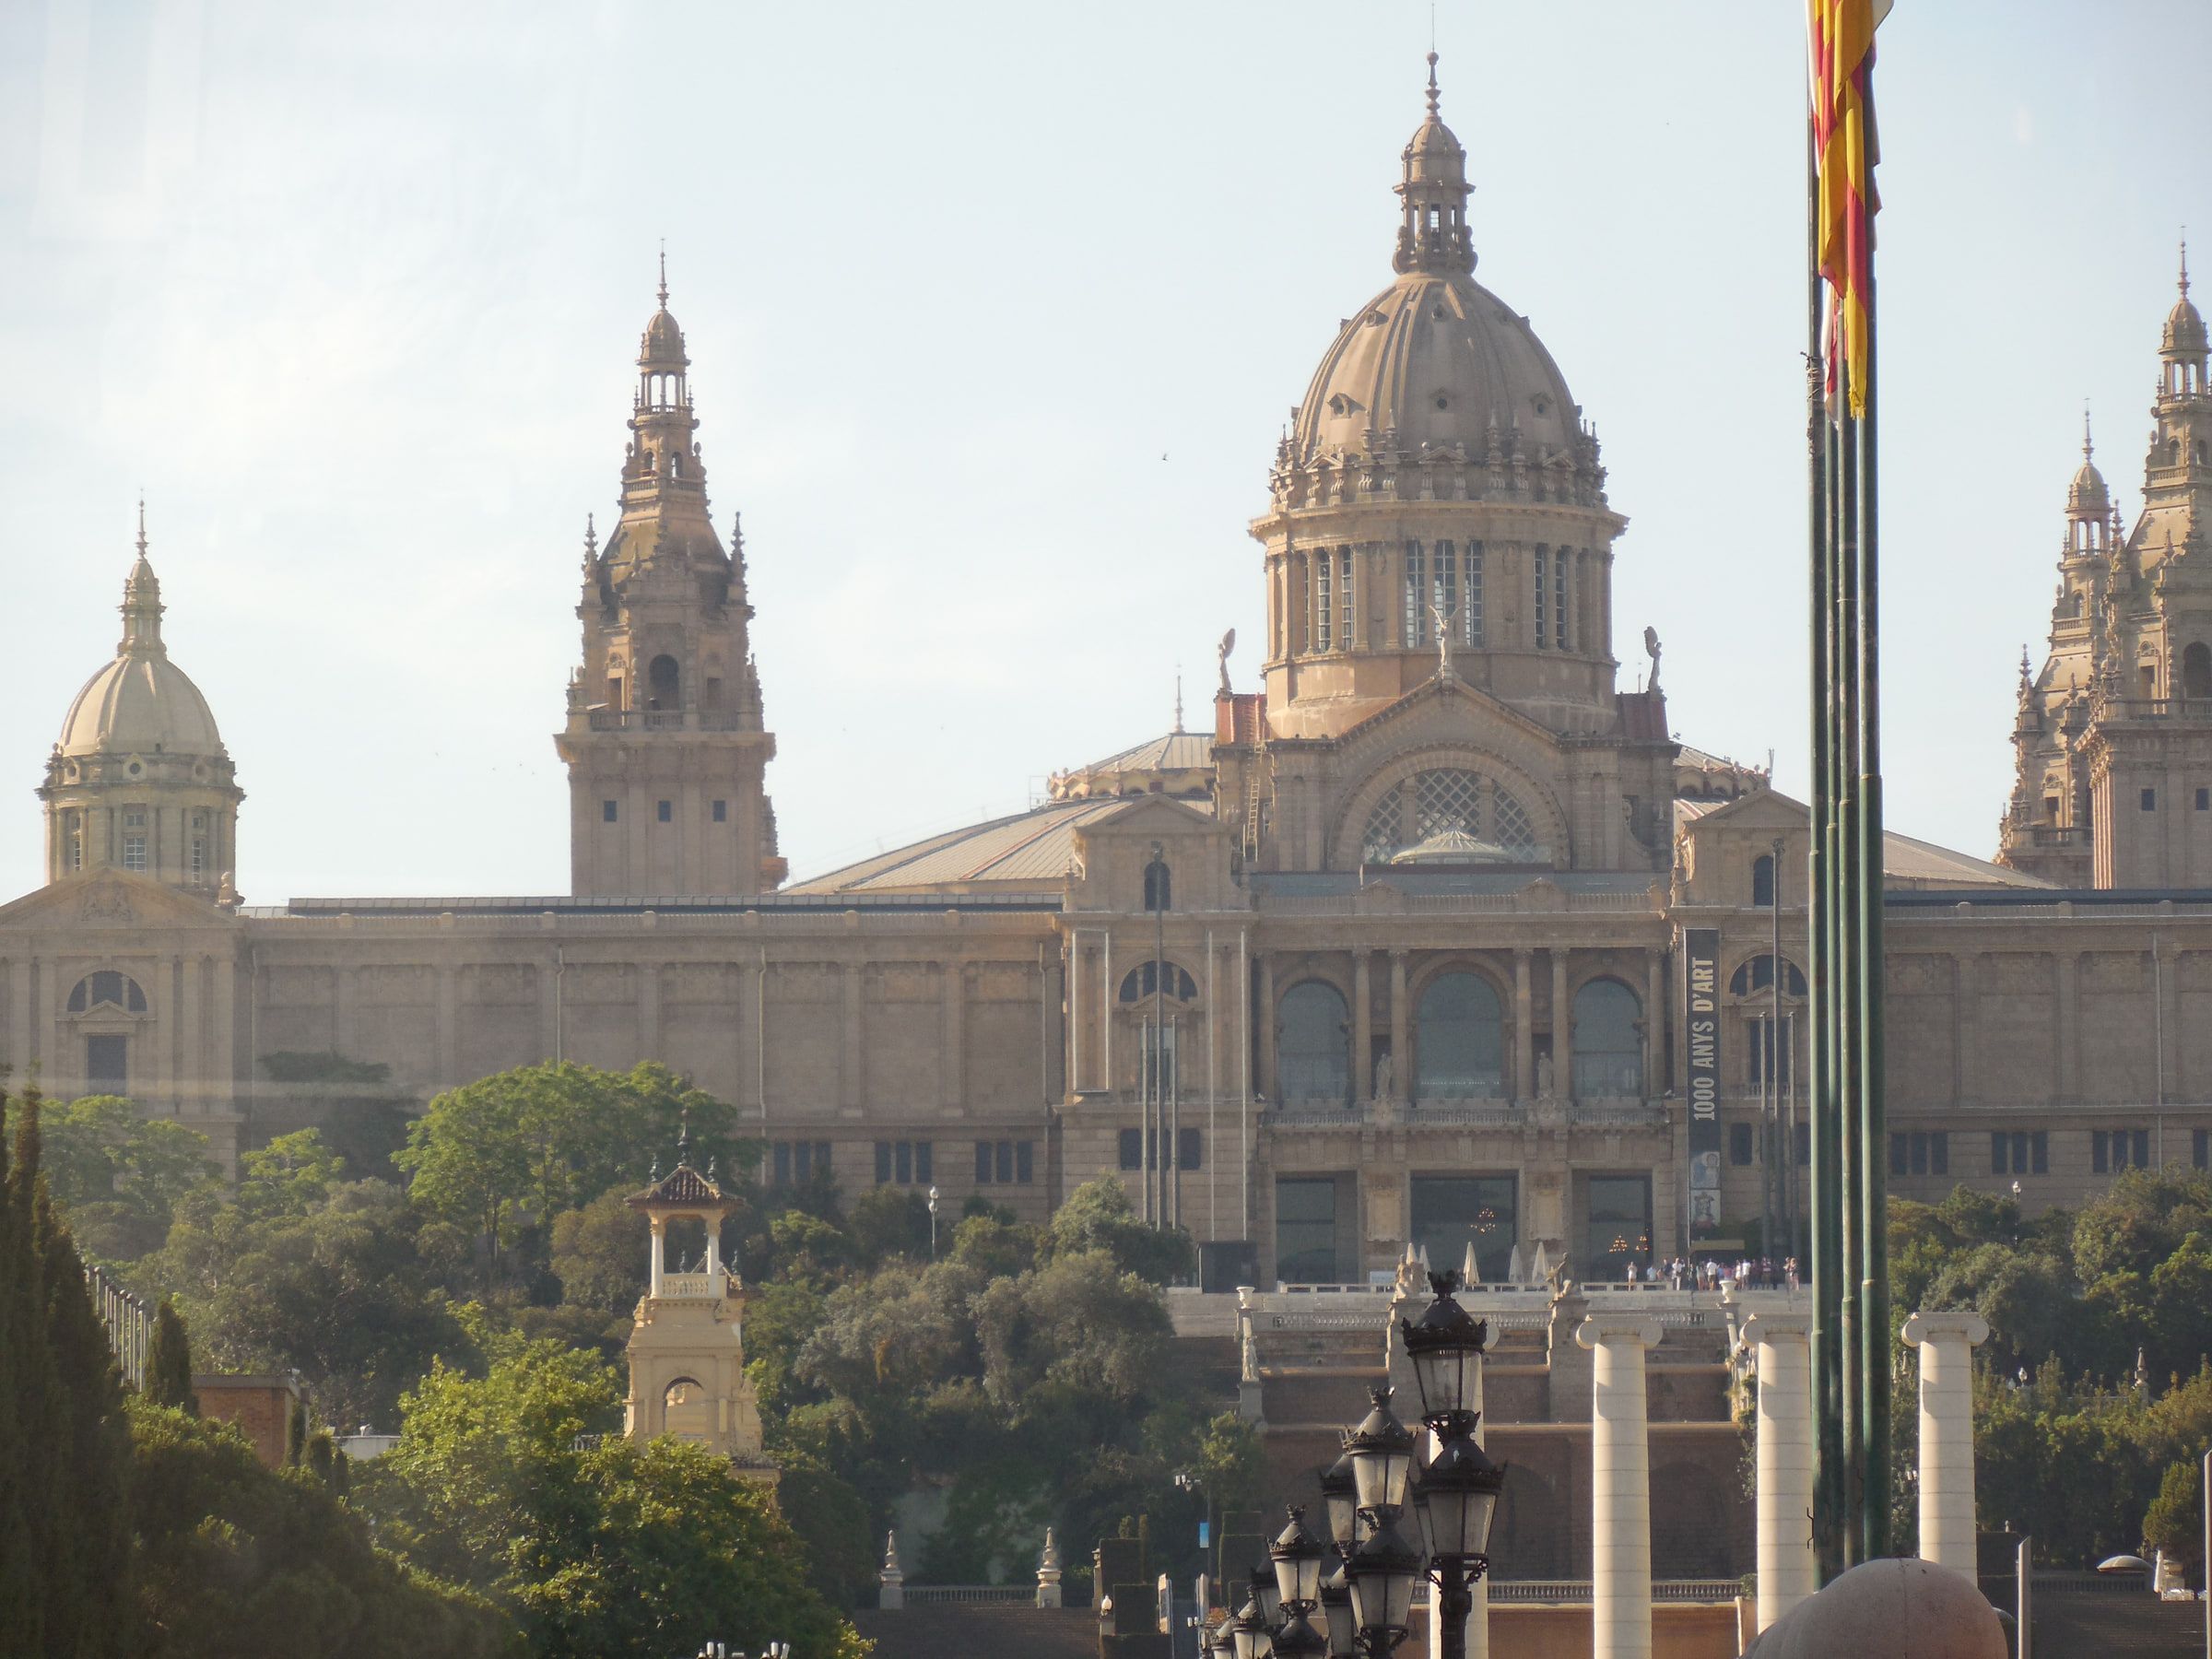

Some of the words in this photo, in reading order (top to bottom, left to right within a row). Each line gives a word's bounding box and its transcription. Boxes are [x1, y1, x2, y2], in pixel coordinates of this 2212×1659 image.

[1692, 957, 1714, 1012] D'ART
[1692, 1021, 1714, 1068] ANYS
[1693, 1077, 1715, 1121] 1000
